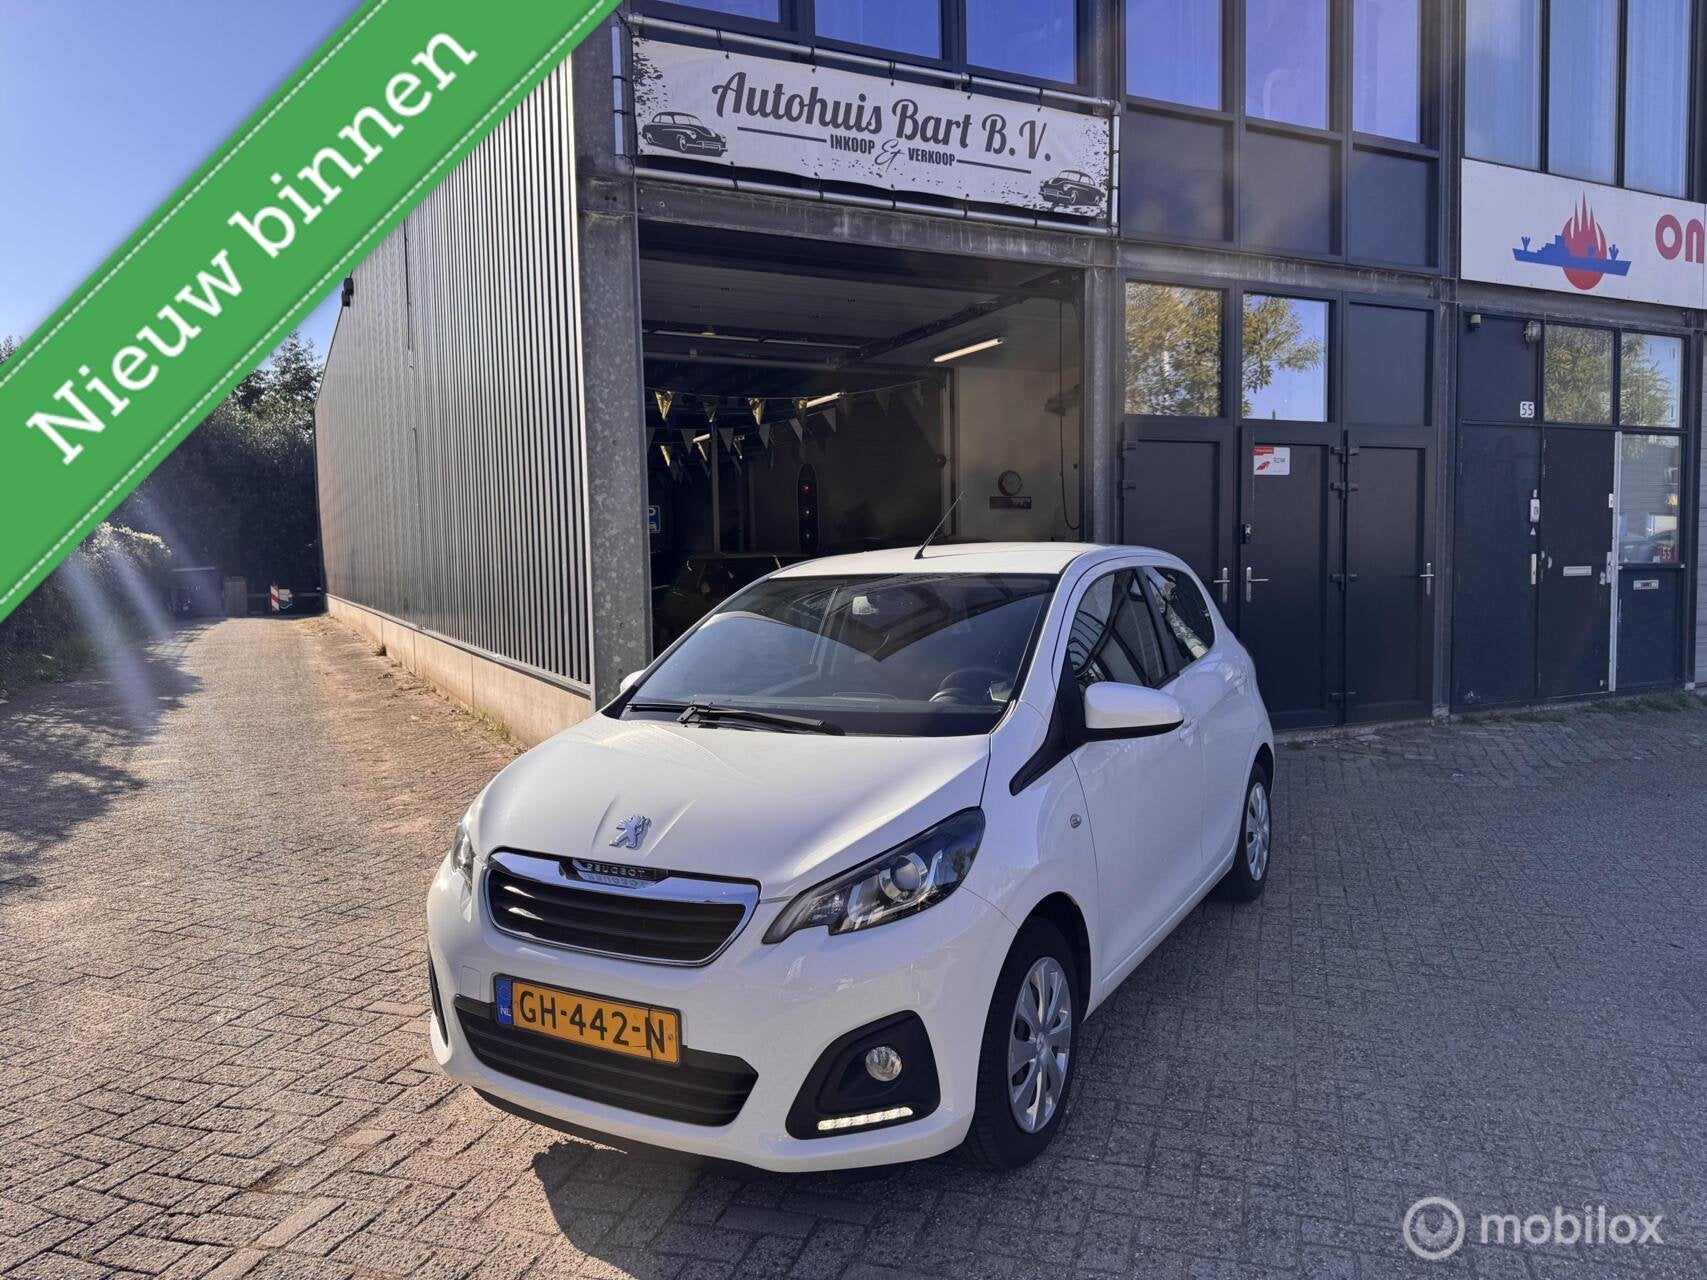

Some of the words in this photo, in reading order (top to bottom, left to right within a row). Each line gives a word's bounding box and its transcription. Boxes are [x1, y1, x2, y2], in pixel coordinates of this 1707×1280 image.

[712, 72, 882, 134] Autohuis
[892, 99, 972, 149] Bart
[982, 114, 1051, 161] B.V.
[830, 134, 875, 154] INKOOP
[908, 147, 955, 166] VERKOOP
[1521, 403, 1533, 416] 55
[500, 1007, 511, 1017] NL
[519, 990, 665, 1053] GH-442-N
